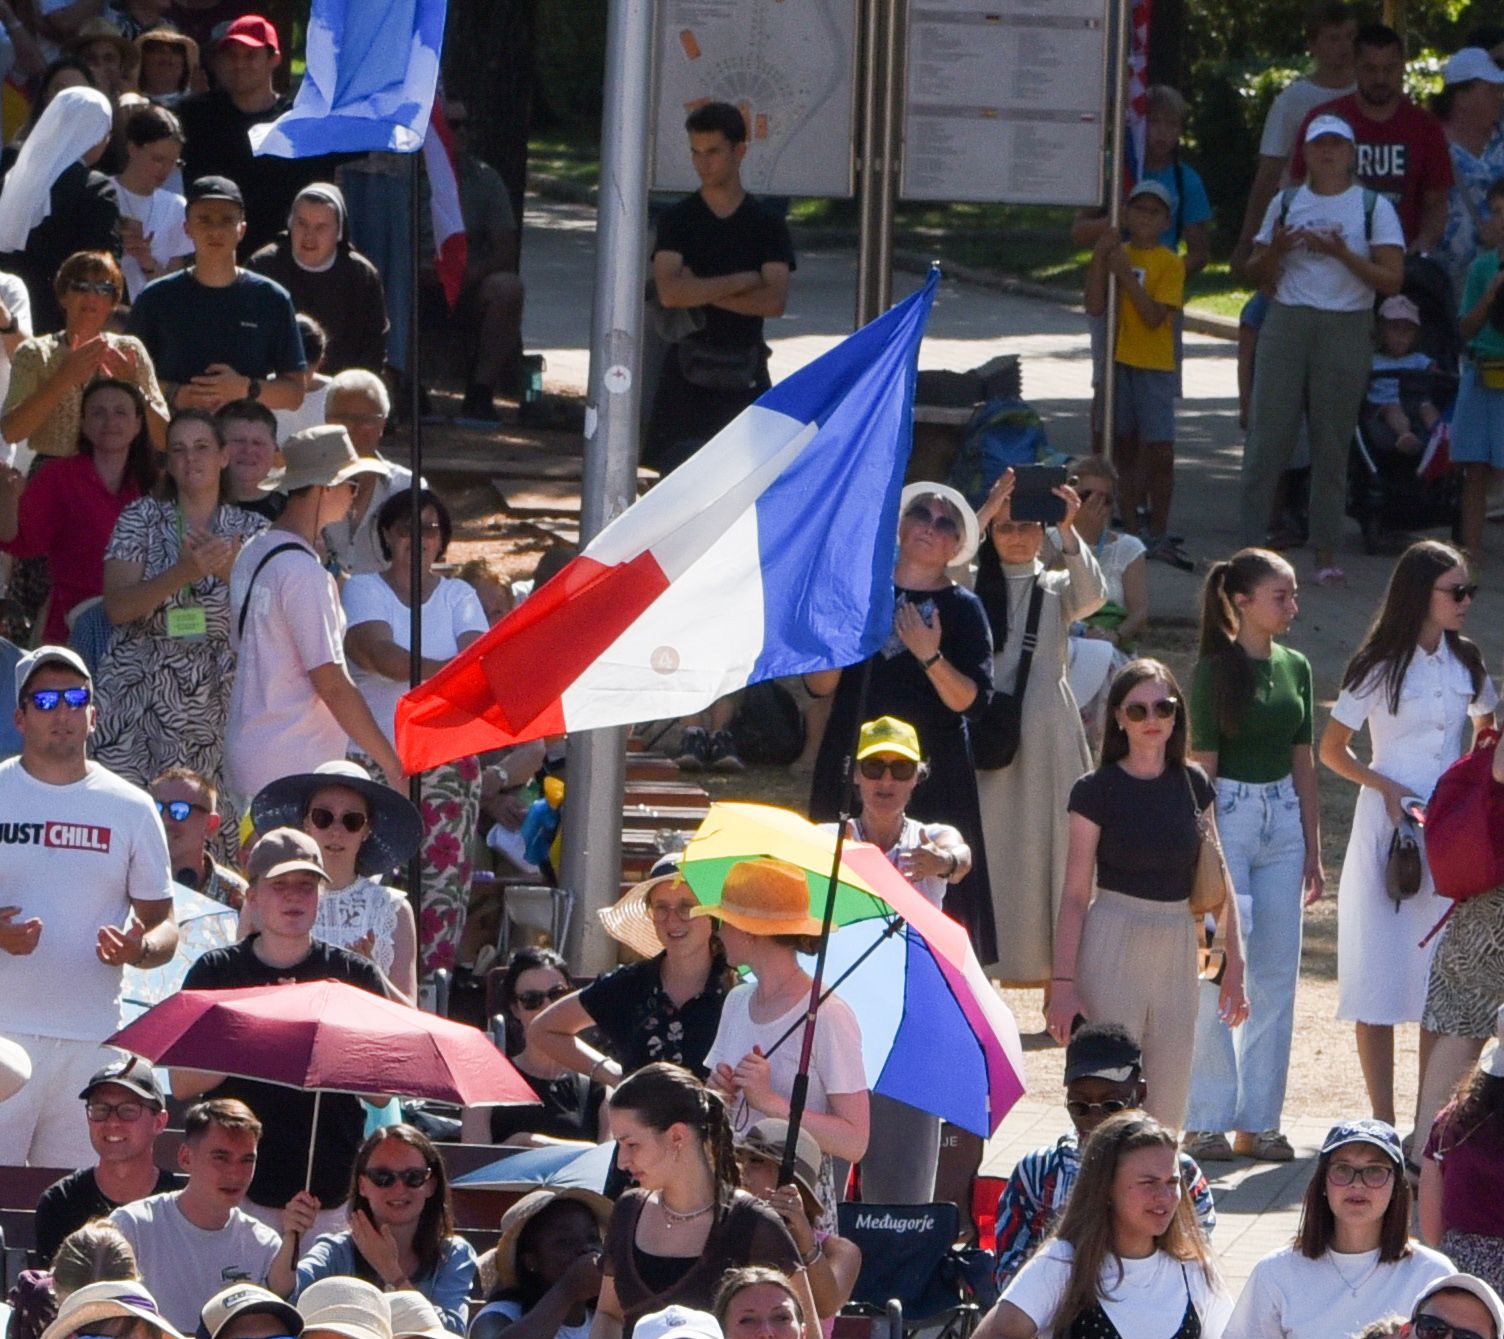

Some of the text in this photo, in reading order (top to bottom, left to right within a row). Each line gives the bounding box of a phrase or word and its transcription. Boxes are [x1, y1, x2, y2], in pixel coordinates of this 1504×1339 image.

[1357, 144, 1405, 176] RUE
[49, 825, 107, 850] CHILL.
[941, 1136, 959, 1147] JE
[855, 1213, 935, 1233] Međugorje
